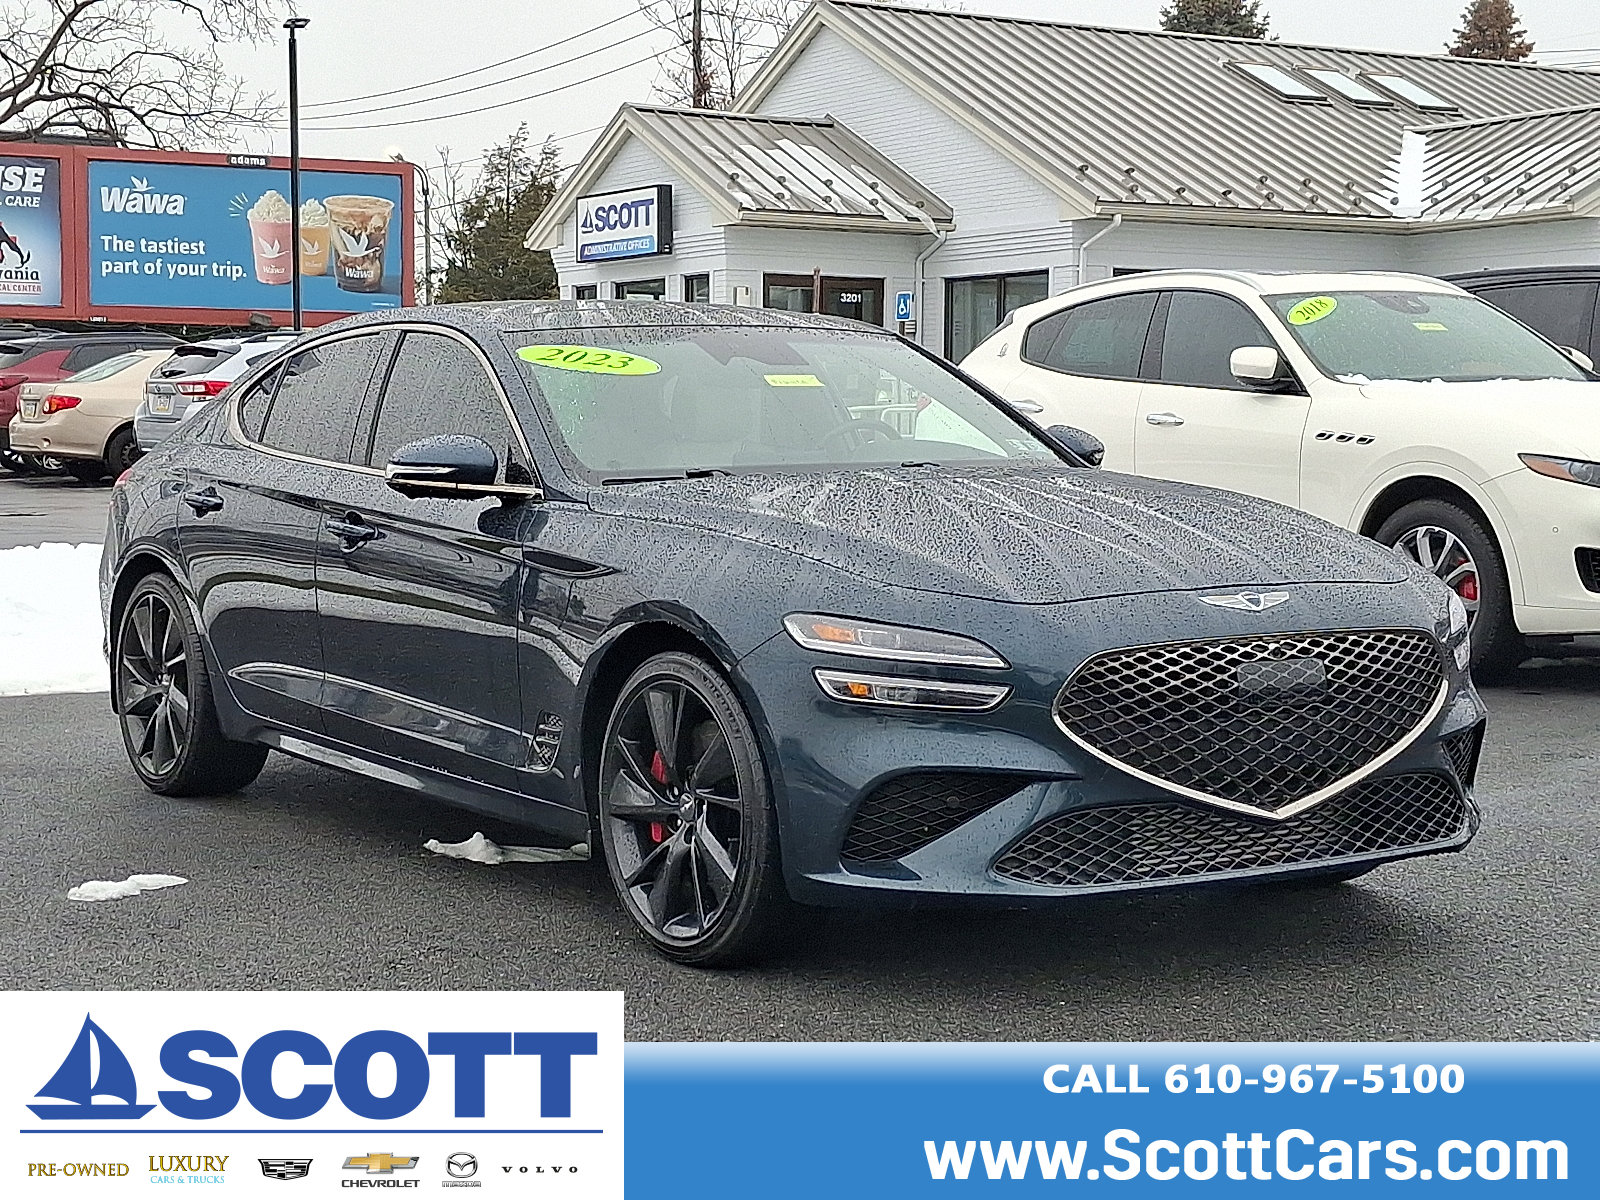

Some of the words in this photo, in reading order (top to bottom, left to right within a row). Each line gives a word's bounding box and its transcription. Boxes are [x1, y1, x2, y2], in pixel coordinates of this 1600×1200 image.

[0, 165, 46, 193] SE
[4, 195, 41, 208] CARE
[100, 186, 186, 215] Wawa
[595, 198, 655, 233] SCOTT
[101, 235, 135, 253] The
[140, 237, 206, 255] tastiest
[584, 242, 627, 256] ADMINISTRATIVE
[627, 239, 650, 251] OFFICES
[101, 259, 139, 278] part
[144, 258, 163, 275] of
[167, 264, 208, 280] your
[211, 261, 247, 281] trip.
[345, 266, 374, 279] Wawa
[840, 292, 862, 303] 3201
[1296, 299, 1328, 321] 2018
[536, 348, 634, 369] 2023
